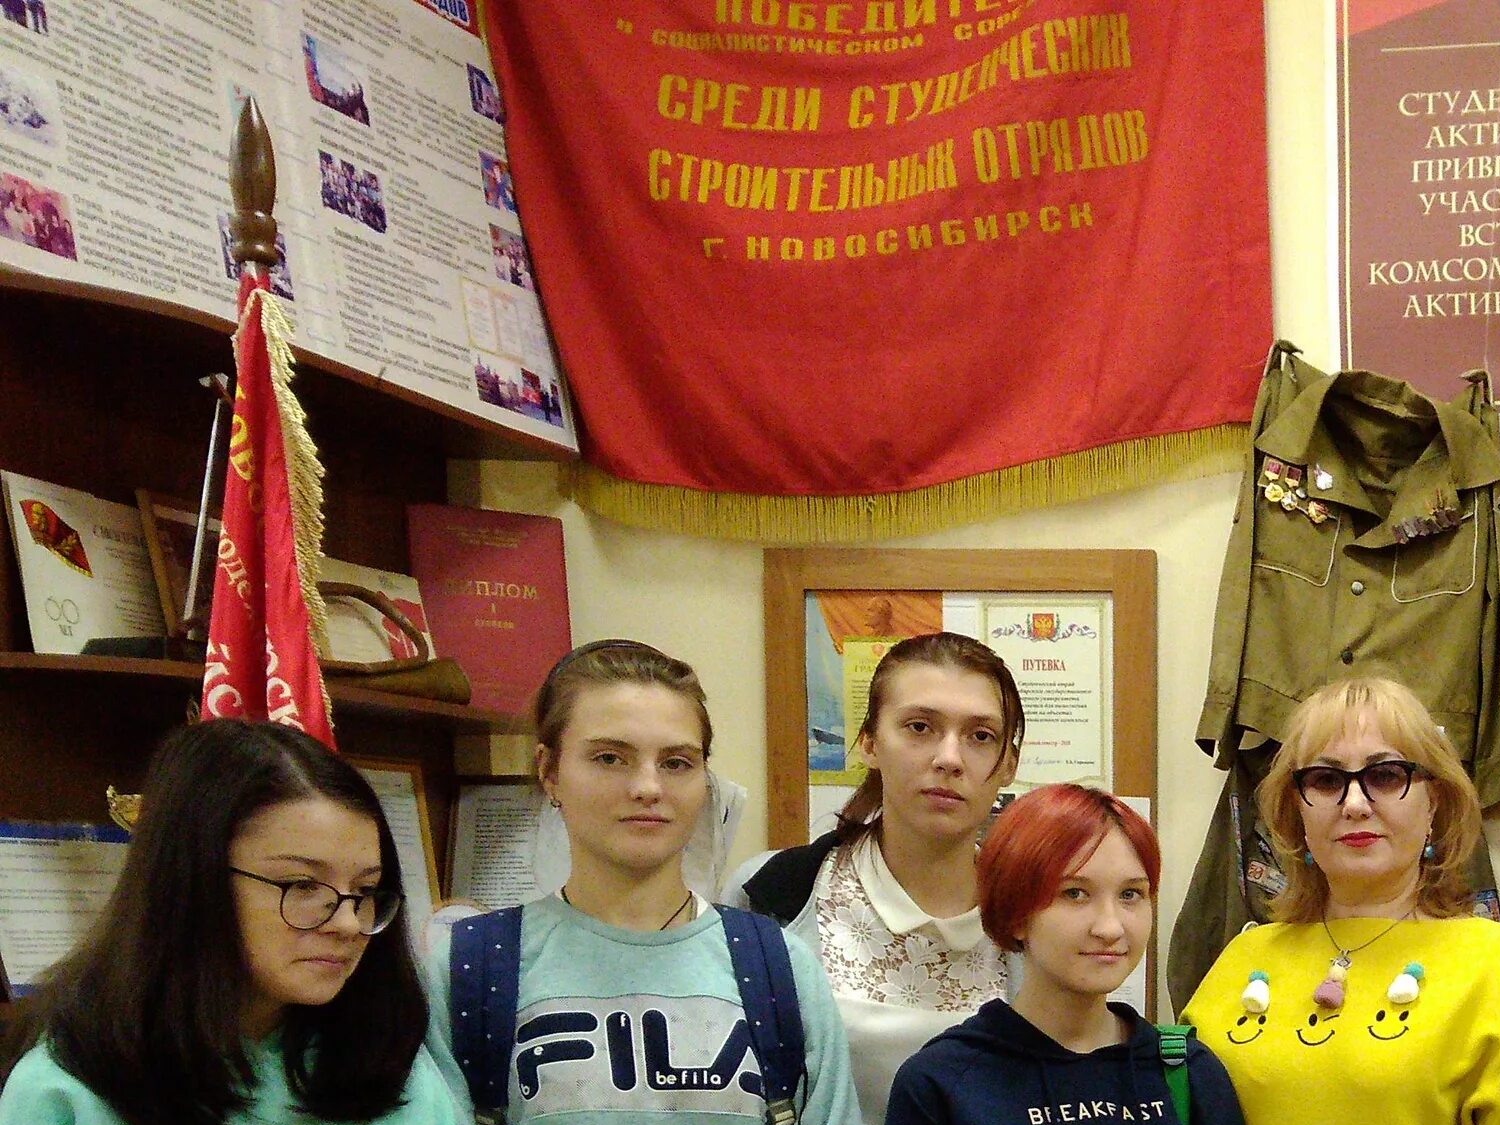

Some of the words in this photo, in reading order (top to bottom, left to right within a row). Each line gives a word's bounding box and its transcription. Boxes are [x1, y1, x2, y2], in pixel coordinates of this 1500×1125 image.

[656, 73, 821, 132] СРЕДИ
[847, 12, 1133, 131] СТУДЕНЧЕСКИХ
[646, 137, 959, 215] СТРОИТЕЛЬНЫХ
[970, 109, 1150, 185] ОТРЯДОВ
[745, 201, 1096, 262] НОВОСИБИРСК
[1021, 658, 1067, 672] ПУТЕВКА
[655, 1071, 678, 1086] be
